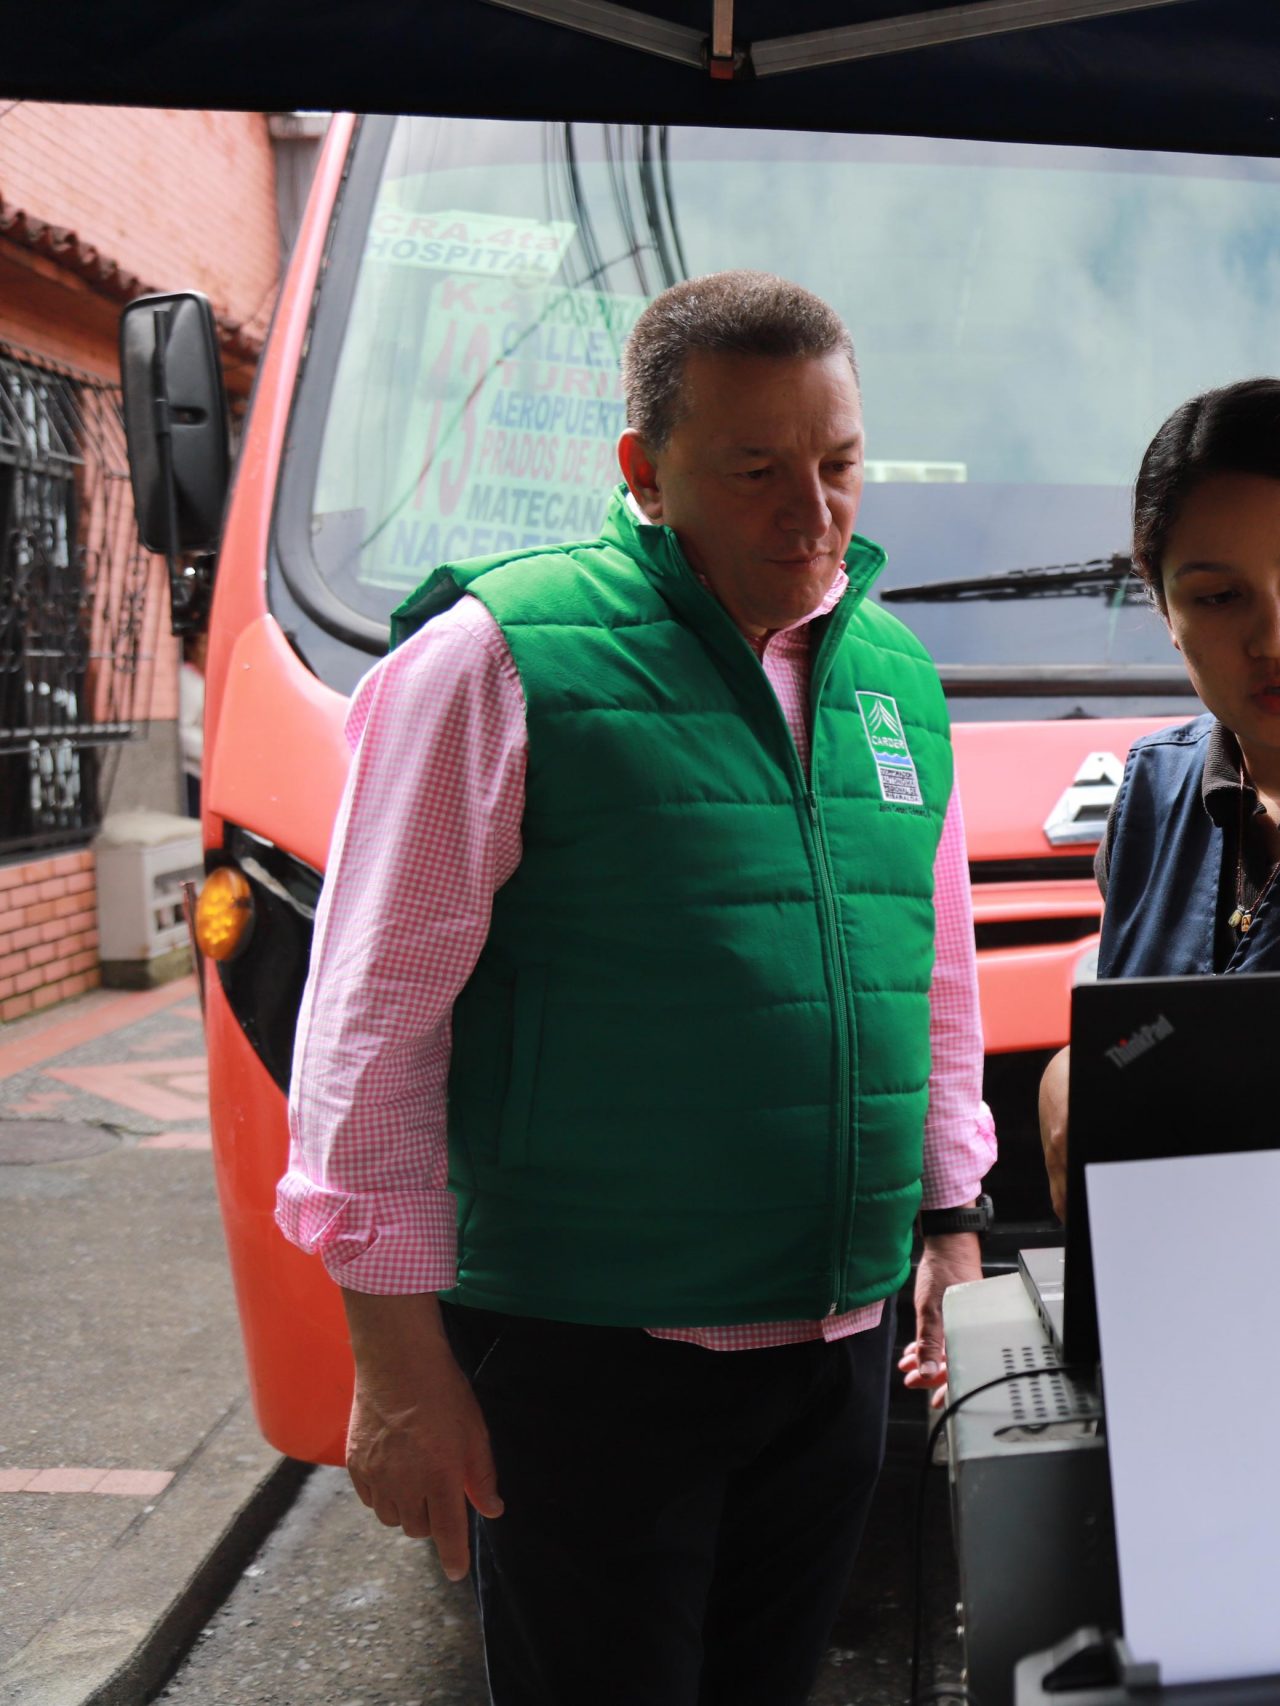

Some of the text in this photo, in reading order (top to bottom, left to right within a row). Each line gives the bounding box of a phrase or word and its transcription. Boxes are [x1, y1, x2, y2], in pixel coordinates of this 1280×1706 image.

[368, 236, 550, 273] HOSPITAL
[488, 390, 627, 440] AEROPUERT
[477, 428, 560, 480] PRADOS
[561, 438, 591, 485] DE
[466, 484, 604, 535] MATECAÑ
[871, 735, 905, 750] CARDER
